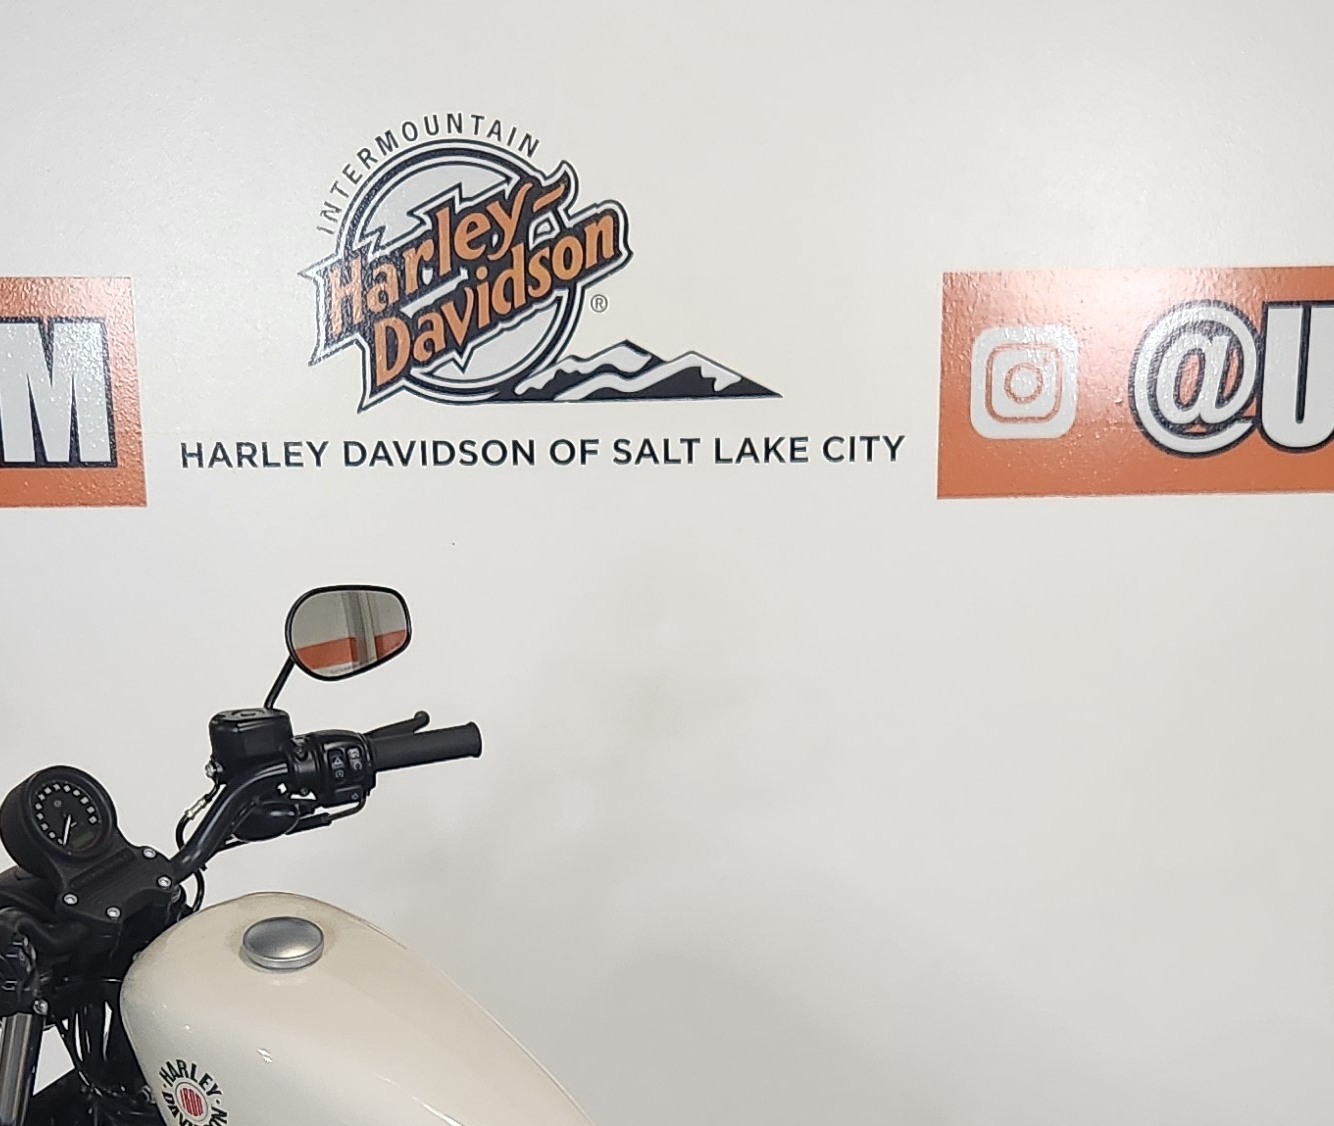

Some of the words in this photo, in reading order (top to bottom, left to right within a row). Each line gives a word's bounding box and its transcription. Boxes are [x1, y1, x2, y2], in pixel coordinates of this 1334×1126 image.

[317, 113, 540, 235] INTERMOUNTAIN
[373, 214, 615, 387] Davidson
[180, 441, 329, 469] HARLEY
[343, 439, 535, 467] DAVIDSON
[549, 438, 600, 465] OF
[612, 437, 701, 465] SALT
[714, 436, 810, 464] LAKE
[822, 434, 906, 463] CITY
[159, 1059, 222, 1097] HARLEY
